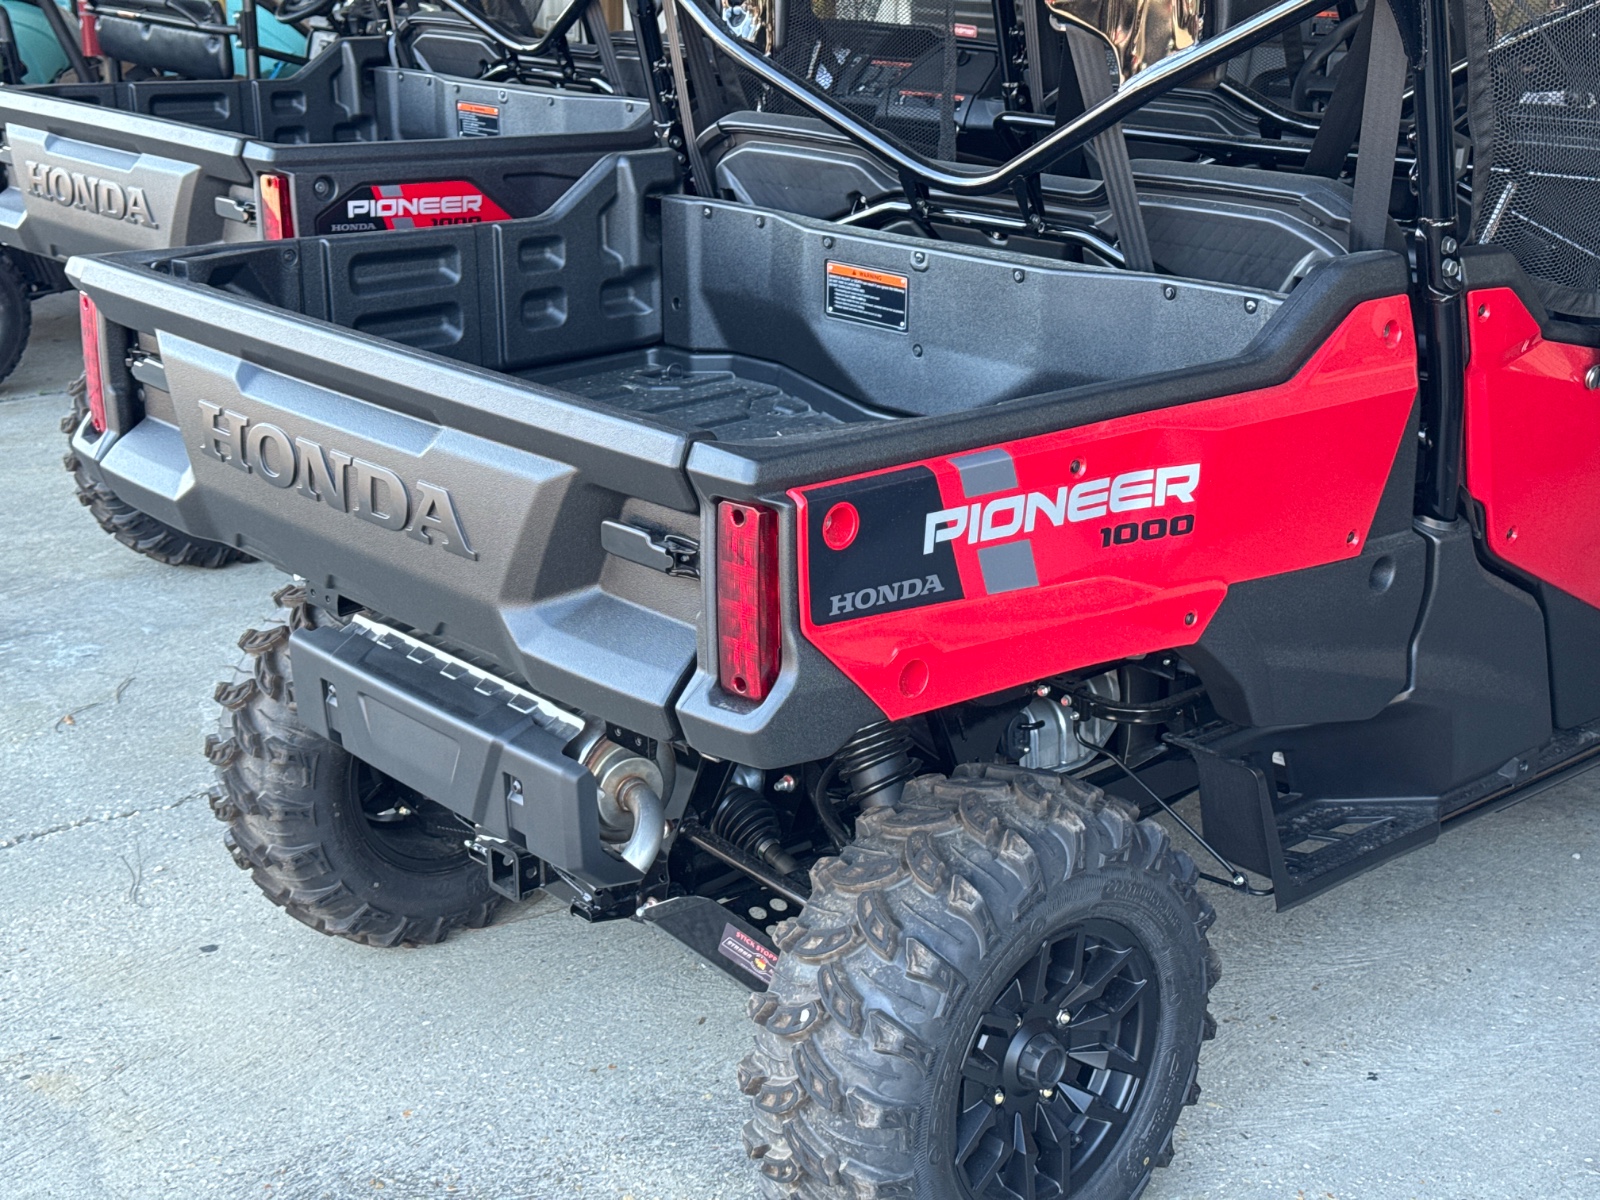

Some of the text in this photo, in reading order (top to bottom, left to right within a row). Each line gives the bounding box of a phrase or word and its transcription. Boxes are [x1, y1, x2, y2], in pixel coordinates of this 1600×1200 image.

[25, 160, 159, 230] HONDA
[347, 194, 482, 218] PIONEER
[331, 222, 376, 231] HONDA
[198, 399, 479, 562] HONDA
[923, 463, 1201, 556] PIONEER
[1100, 514, 1195, 548] 1000
[828, 574, 945, 617] HONDA
[735, 931, 778, 962] STICK STOPP
